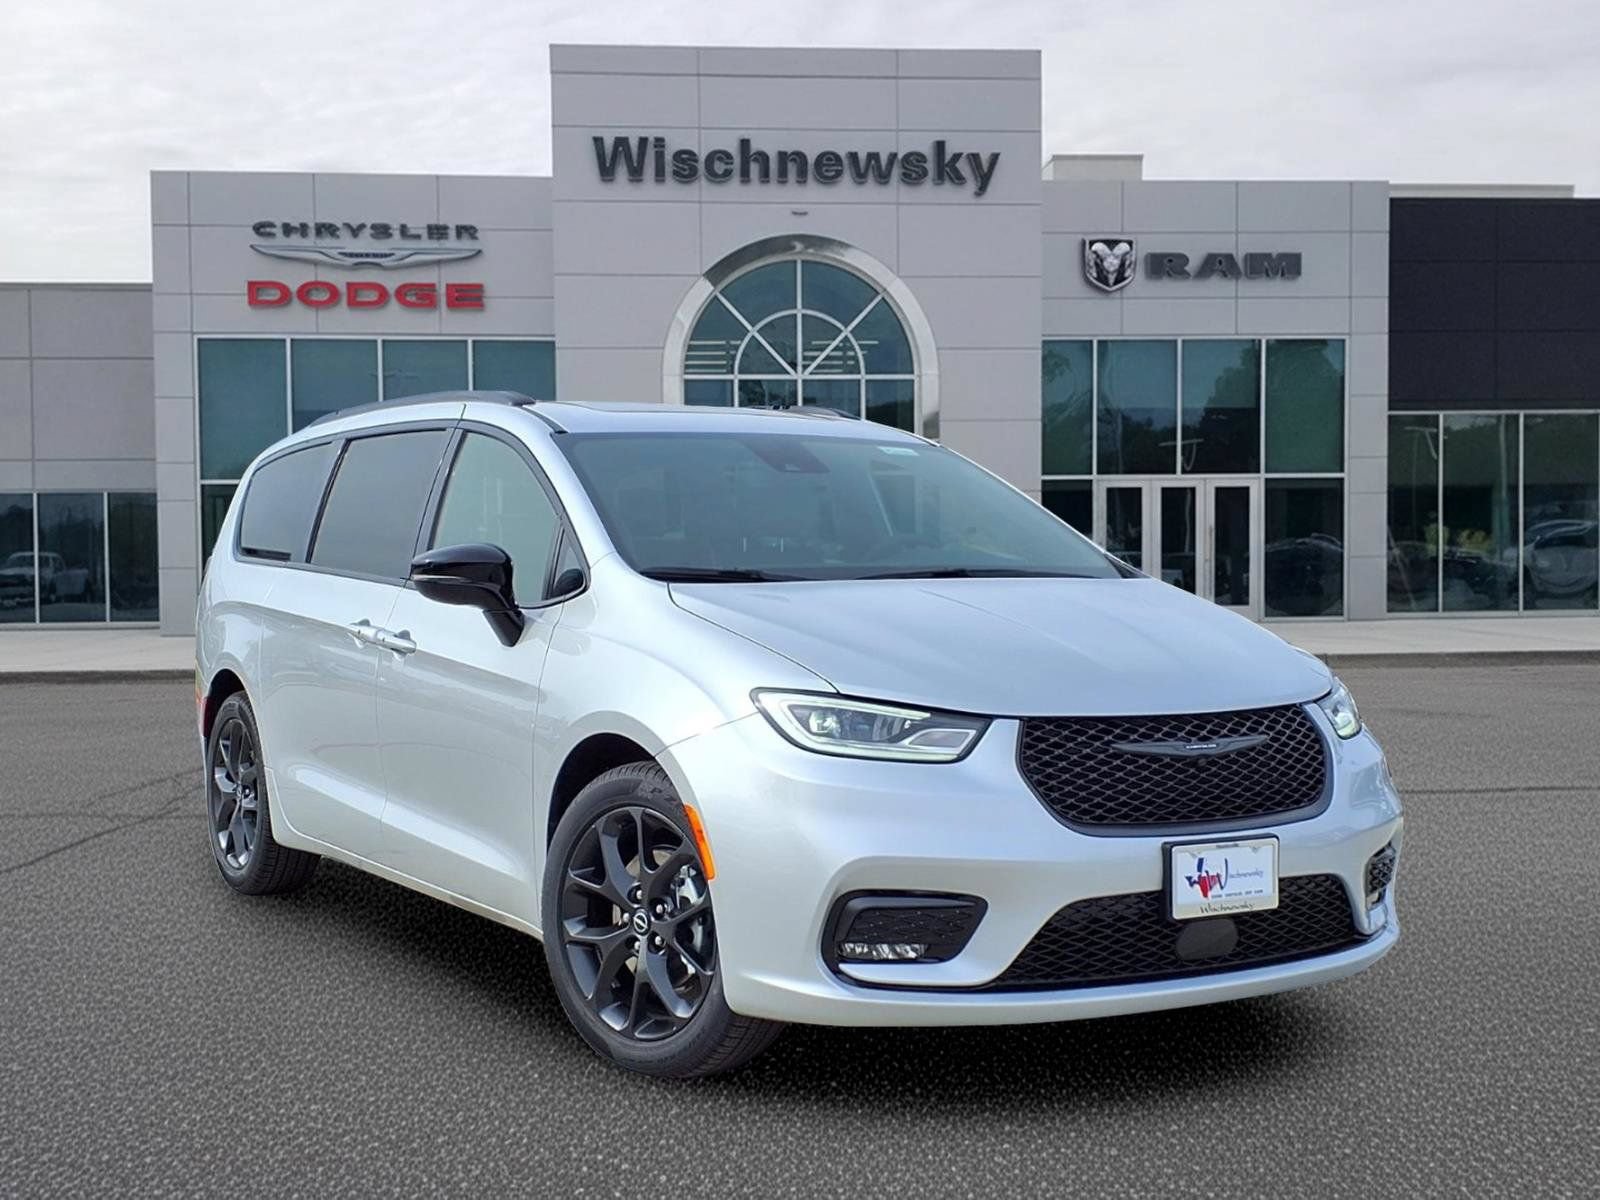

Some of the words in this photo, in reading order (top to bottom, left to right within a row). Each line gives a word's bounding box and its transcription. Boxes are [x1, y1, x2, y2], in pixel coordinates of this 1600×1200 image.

[592, 136, 1000, 197] Wischnewsky
[252, 221, 479, 241] CHRYSLER
[1145, 252, 1302, 280] RAM
[247, 280, 486, 311] DODGE
